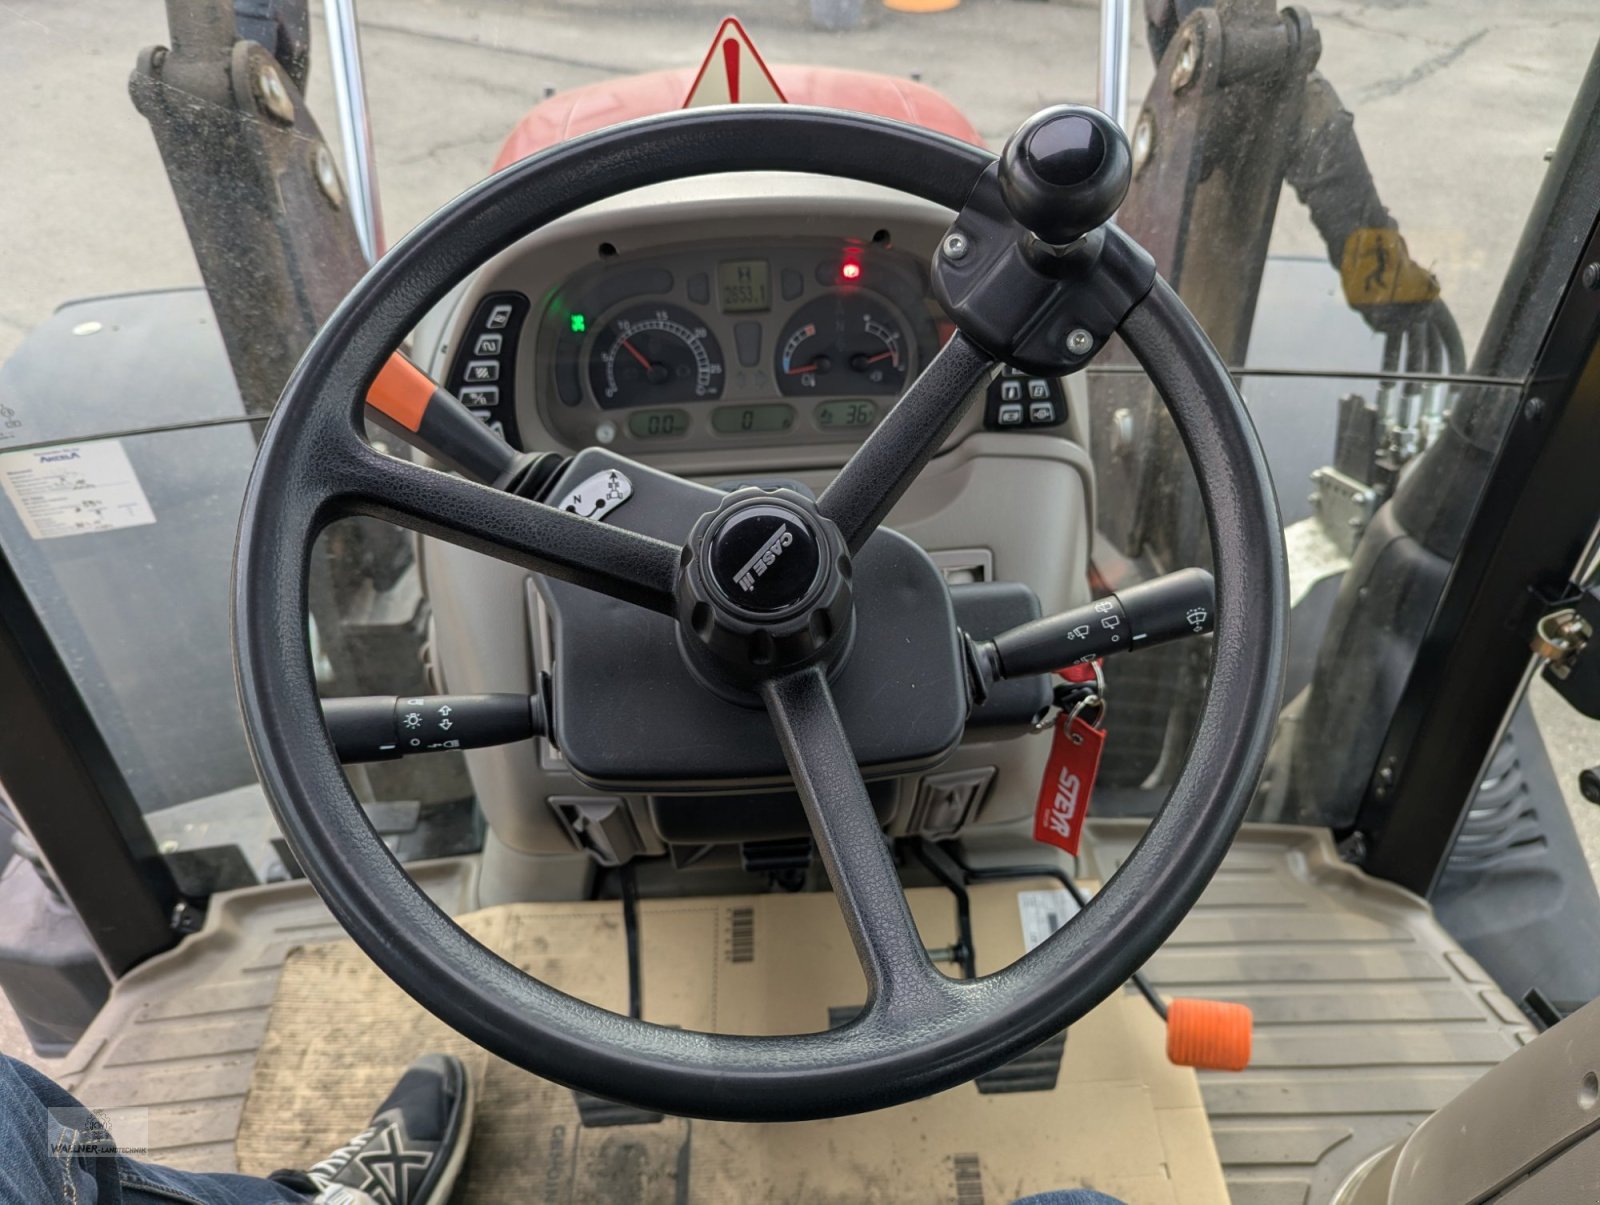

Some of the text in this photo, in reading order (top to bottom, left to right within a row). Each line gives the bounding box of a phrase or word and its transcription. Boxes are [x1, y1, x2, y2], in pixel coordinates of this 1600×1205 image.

[656, 311, 668, 321] 15
[617, 321, 630, 331] 10
[694, 328, 707, 338] 20
[710, 364, 722, 374] 25
[573, 494, 582, 504] N
[1049, 766, 1080, 839] STEYR
